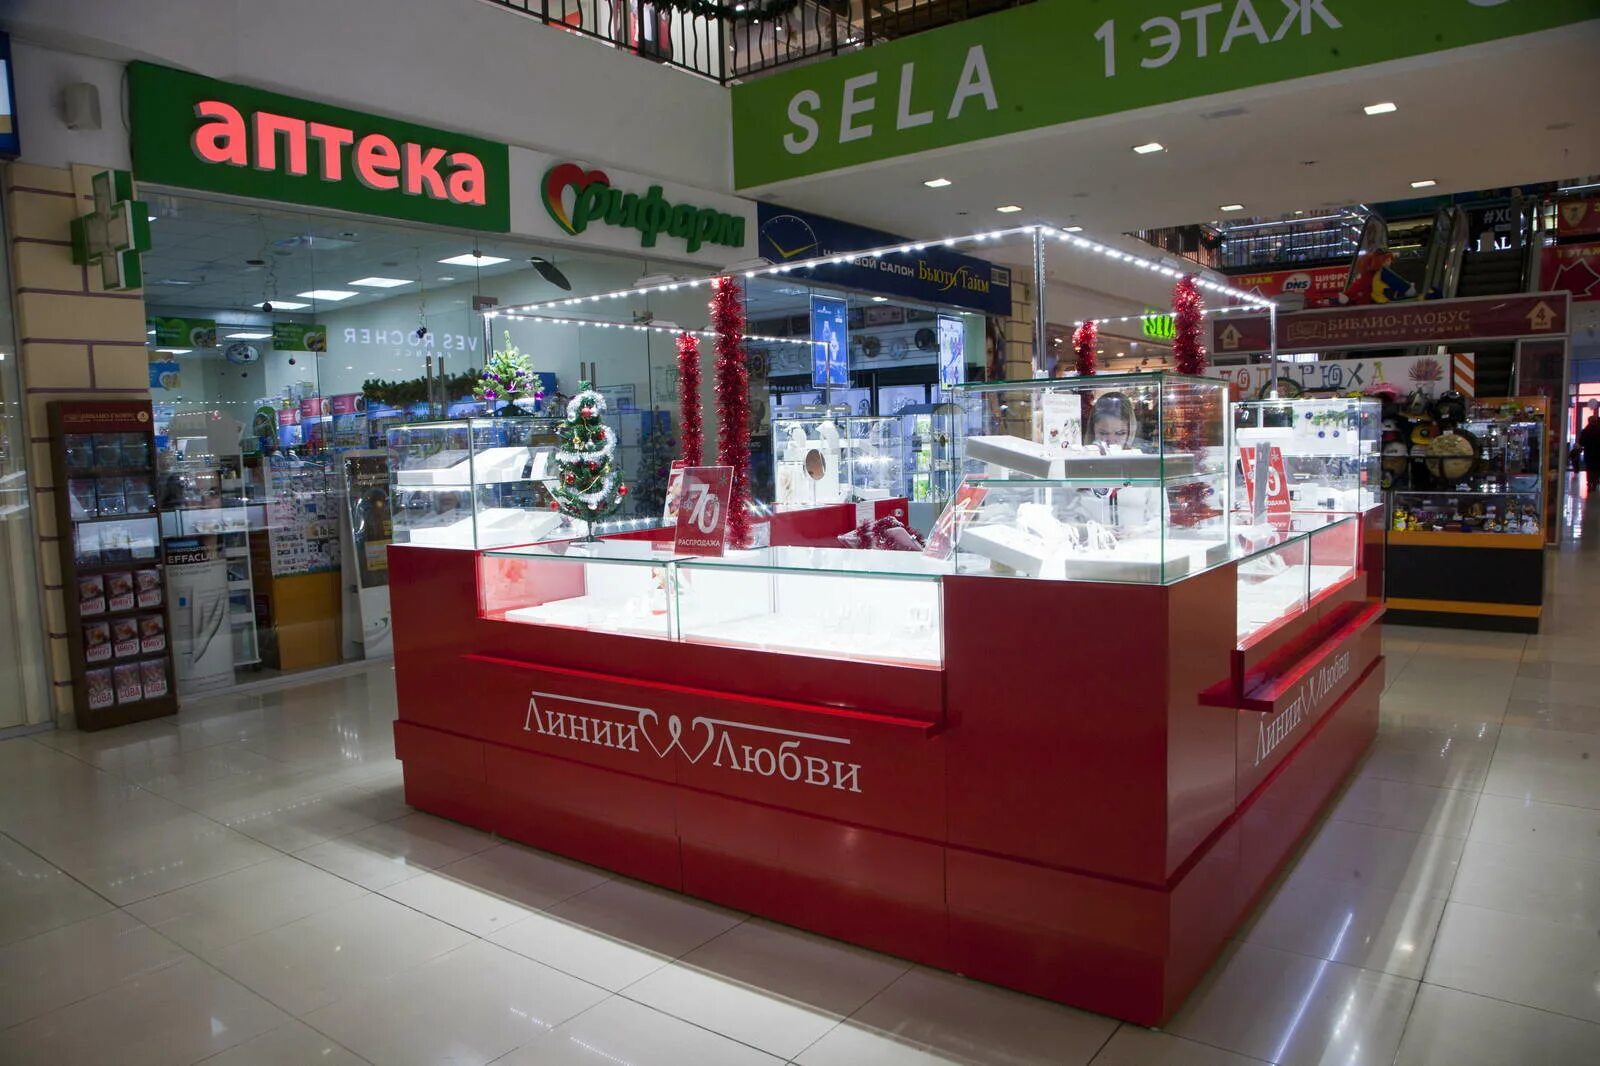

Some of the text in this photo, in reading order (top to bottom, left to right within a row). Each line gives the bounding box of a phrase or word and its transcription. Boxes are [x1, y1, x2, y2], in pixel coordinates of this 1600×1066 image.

[783, 0, 1342, 155] SELA 1 ЭТАЖ
[192, 100, 486, 205] аптека
[879, 261, 914, 277] САЛОН
[958, 269, 990, 293] Тайм
[1285, 280, 1309, 290] DNS
[1328, 310, 1471, 330] БИБЛИО-ГЛОБУС
[688, 484, 720, 534] 70
[678, 538, 721, 547] РАСПРОДАЖА
[1253, 650, 1350, 768] Линии Любви
[522, 697, 863, 793] Линии Любви
